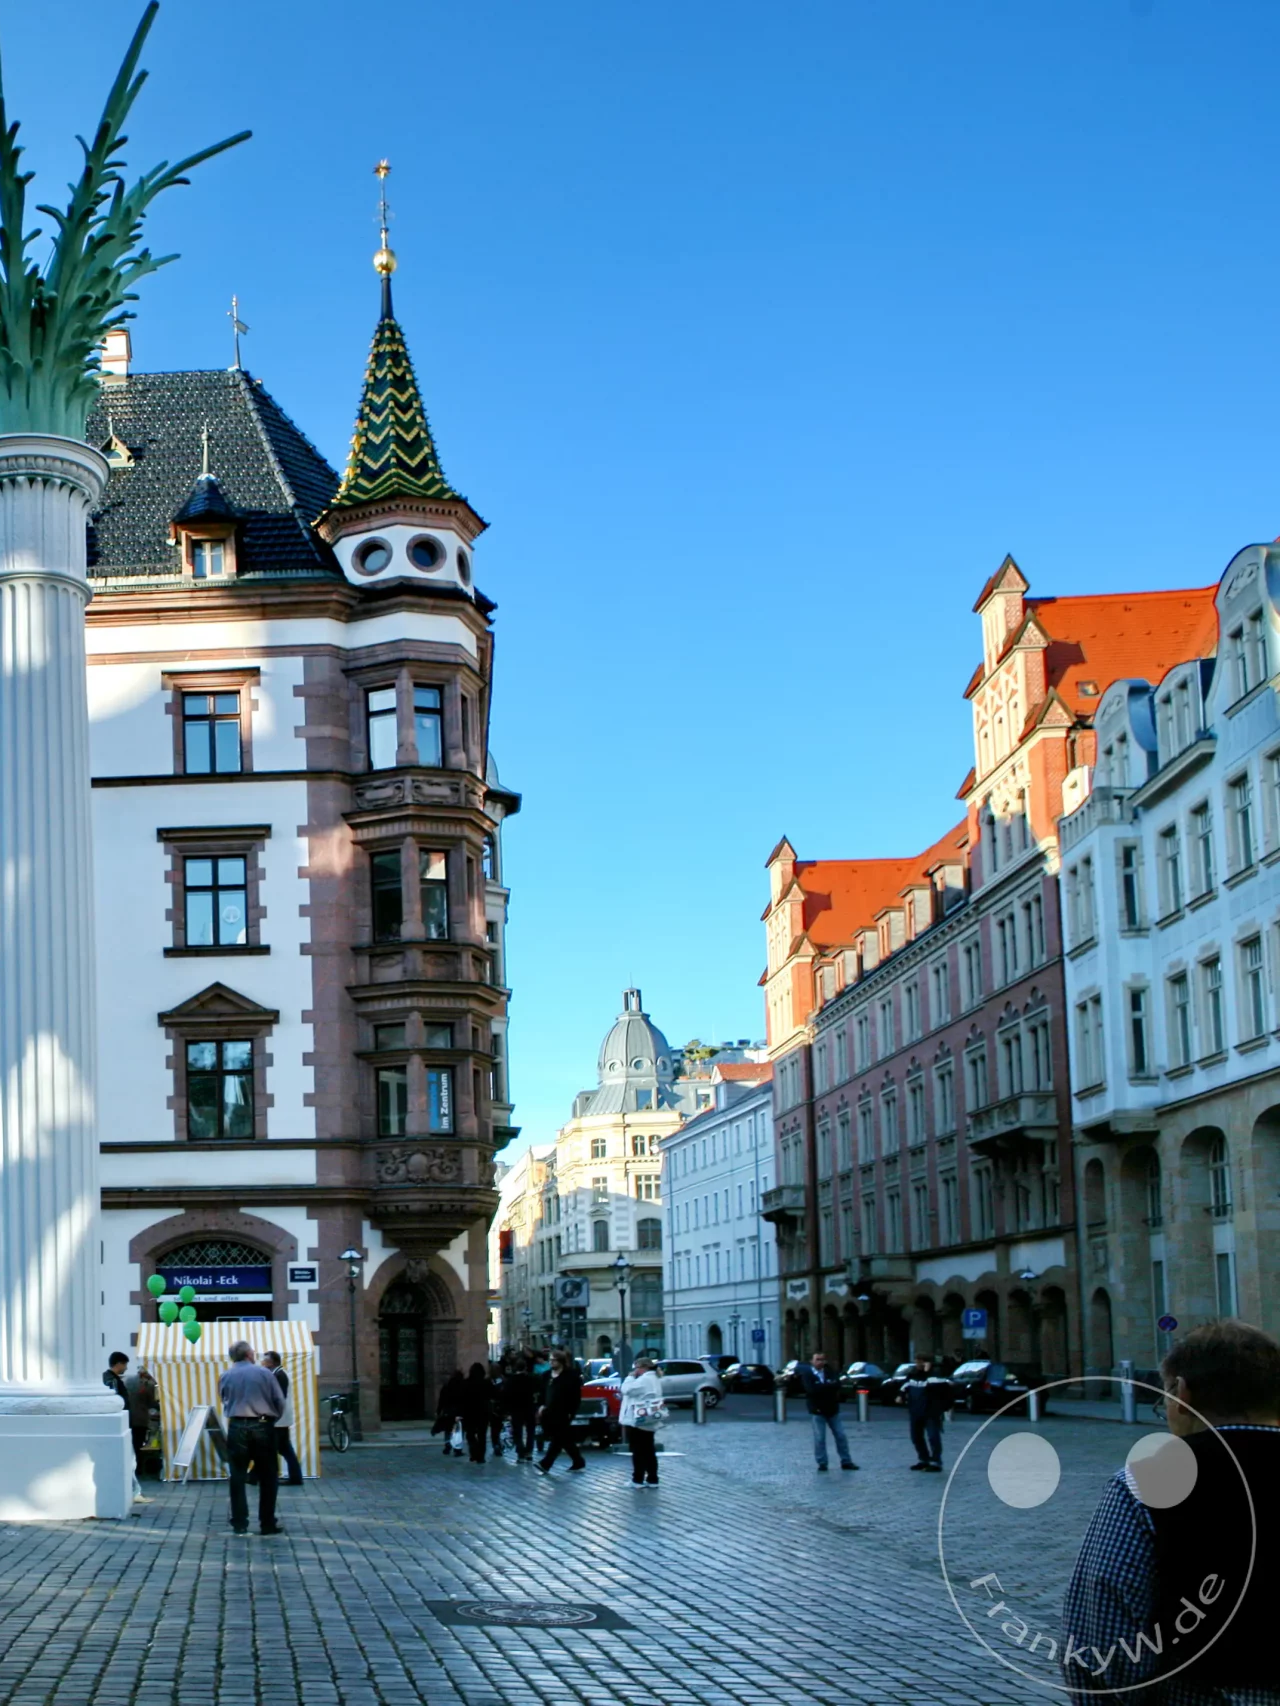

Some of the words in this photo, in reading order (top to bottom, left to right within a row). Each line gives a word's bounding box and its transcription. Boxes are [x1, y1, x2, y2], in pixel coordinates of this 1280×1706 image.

[440, 1073, 449, 1114] Zentrum
[441, 1116, 449, 1128] im
[173, 1275, 213, 1286] Nikolai
[215, 1275, 239, 1285] -Eck
[969, 1311, 982, 1325] P
